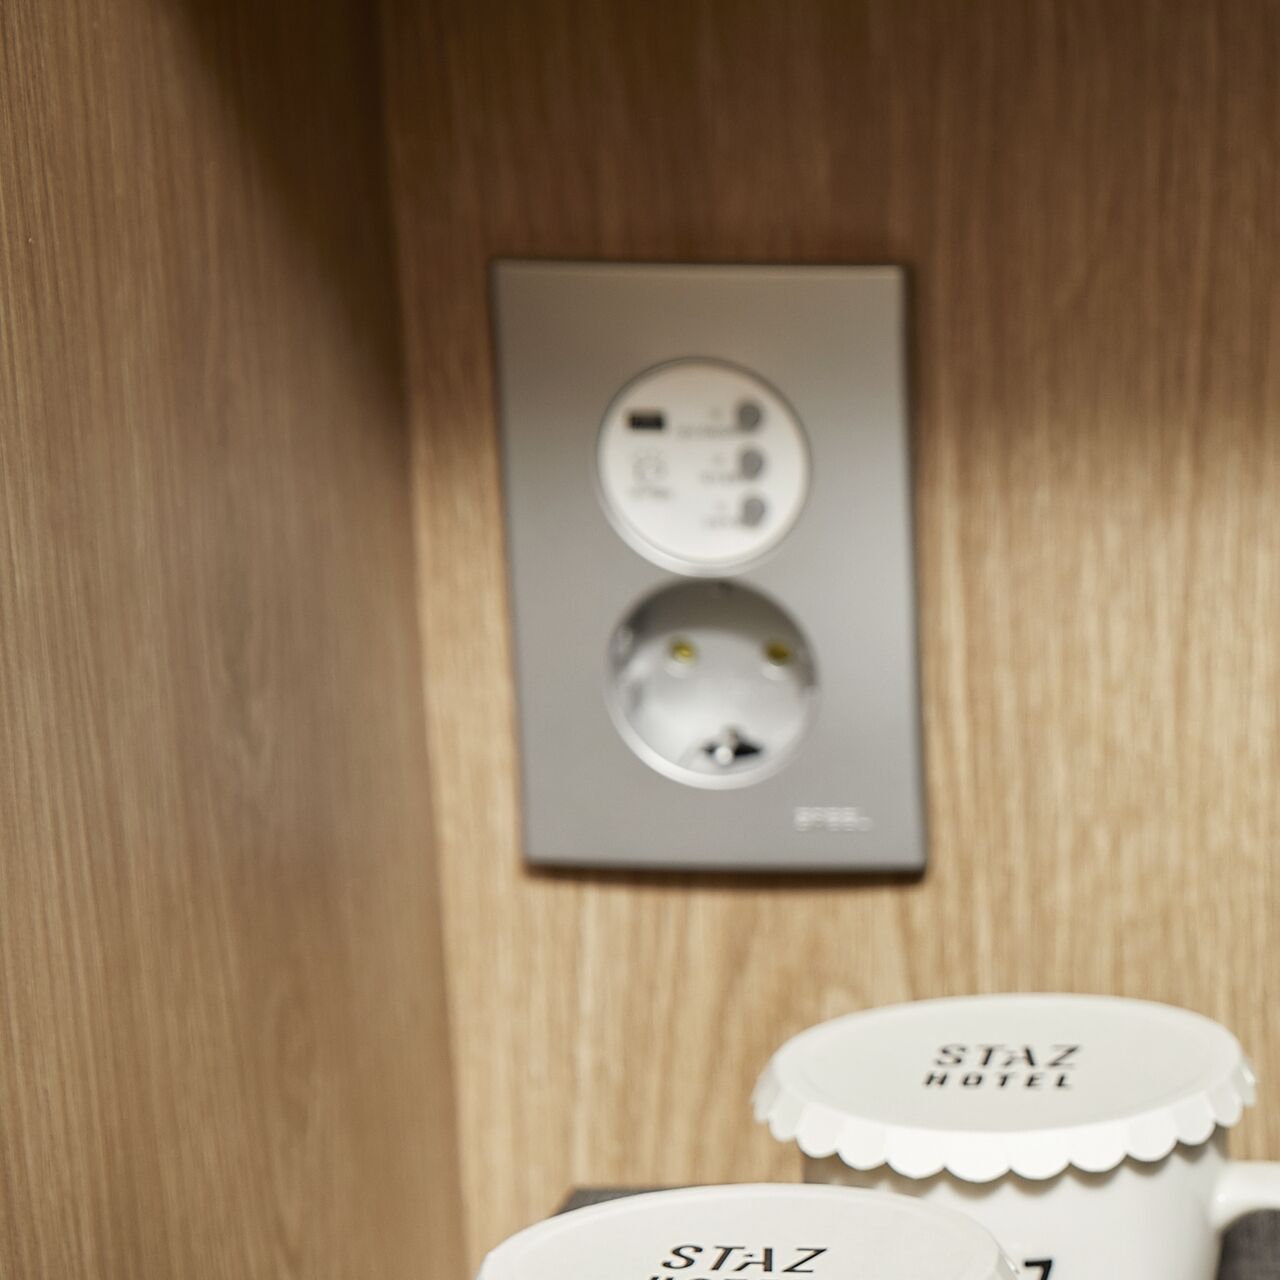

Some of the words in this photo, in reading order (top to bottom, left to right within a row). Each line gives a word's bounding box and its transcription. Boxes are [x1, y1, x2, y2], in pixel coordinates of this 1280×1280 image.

[934, 1044, 1081, 1069] STAZ
[924, 1071, 1074, 1089] HOTEL
[661, 1245, 828, 1274] STAZ
